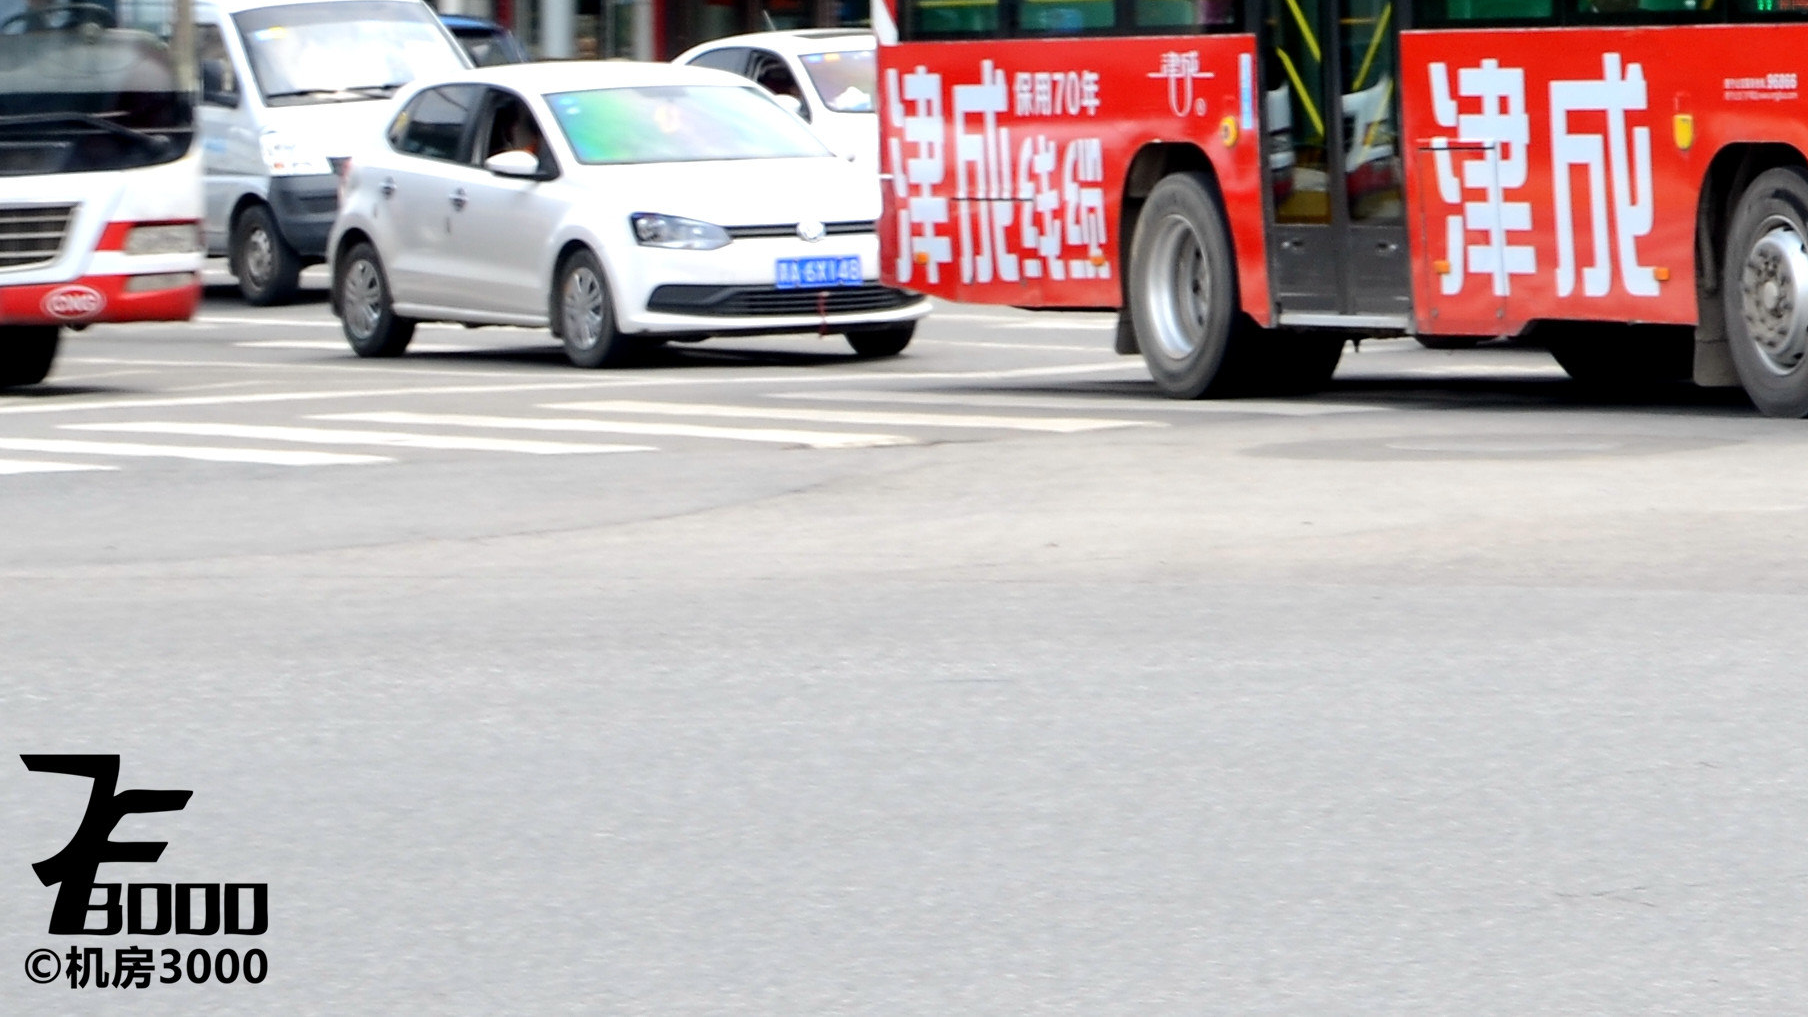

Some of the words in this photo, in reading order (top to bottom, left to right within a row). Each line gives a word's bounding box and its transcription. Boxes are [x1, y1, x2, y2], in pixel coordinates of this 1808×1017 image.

[1013, 69, 1101, 116] 保用70年
[1428, 52, 1661, 298] 津成
